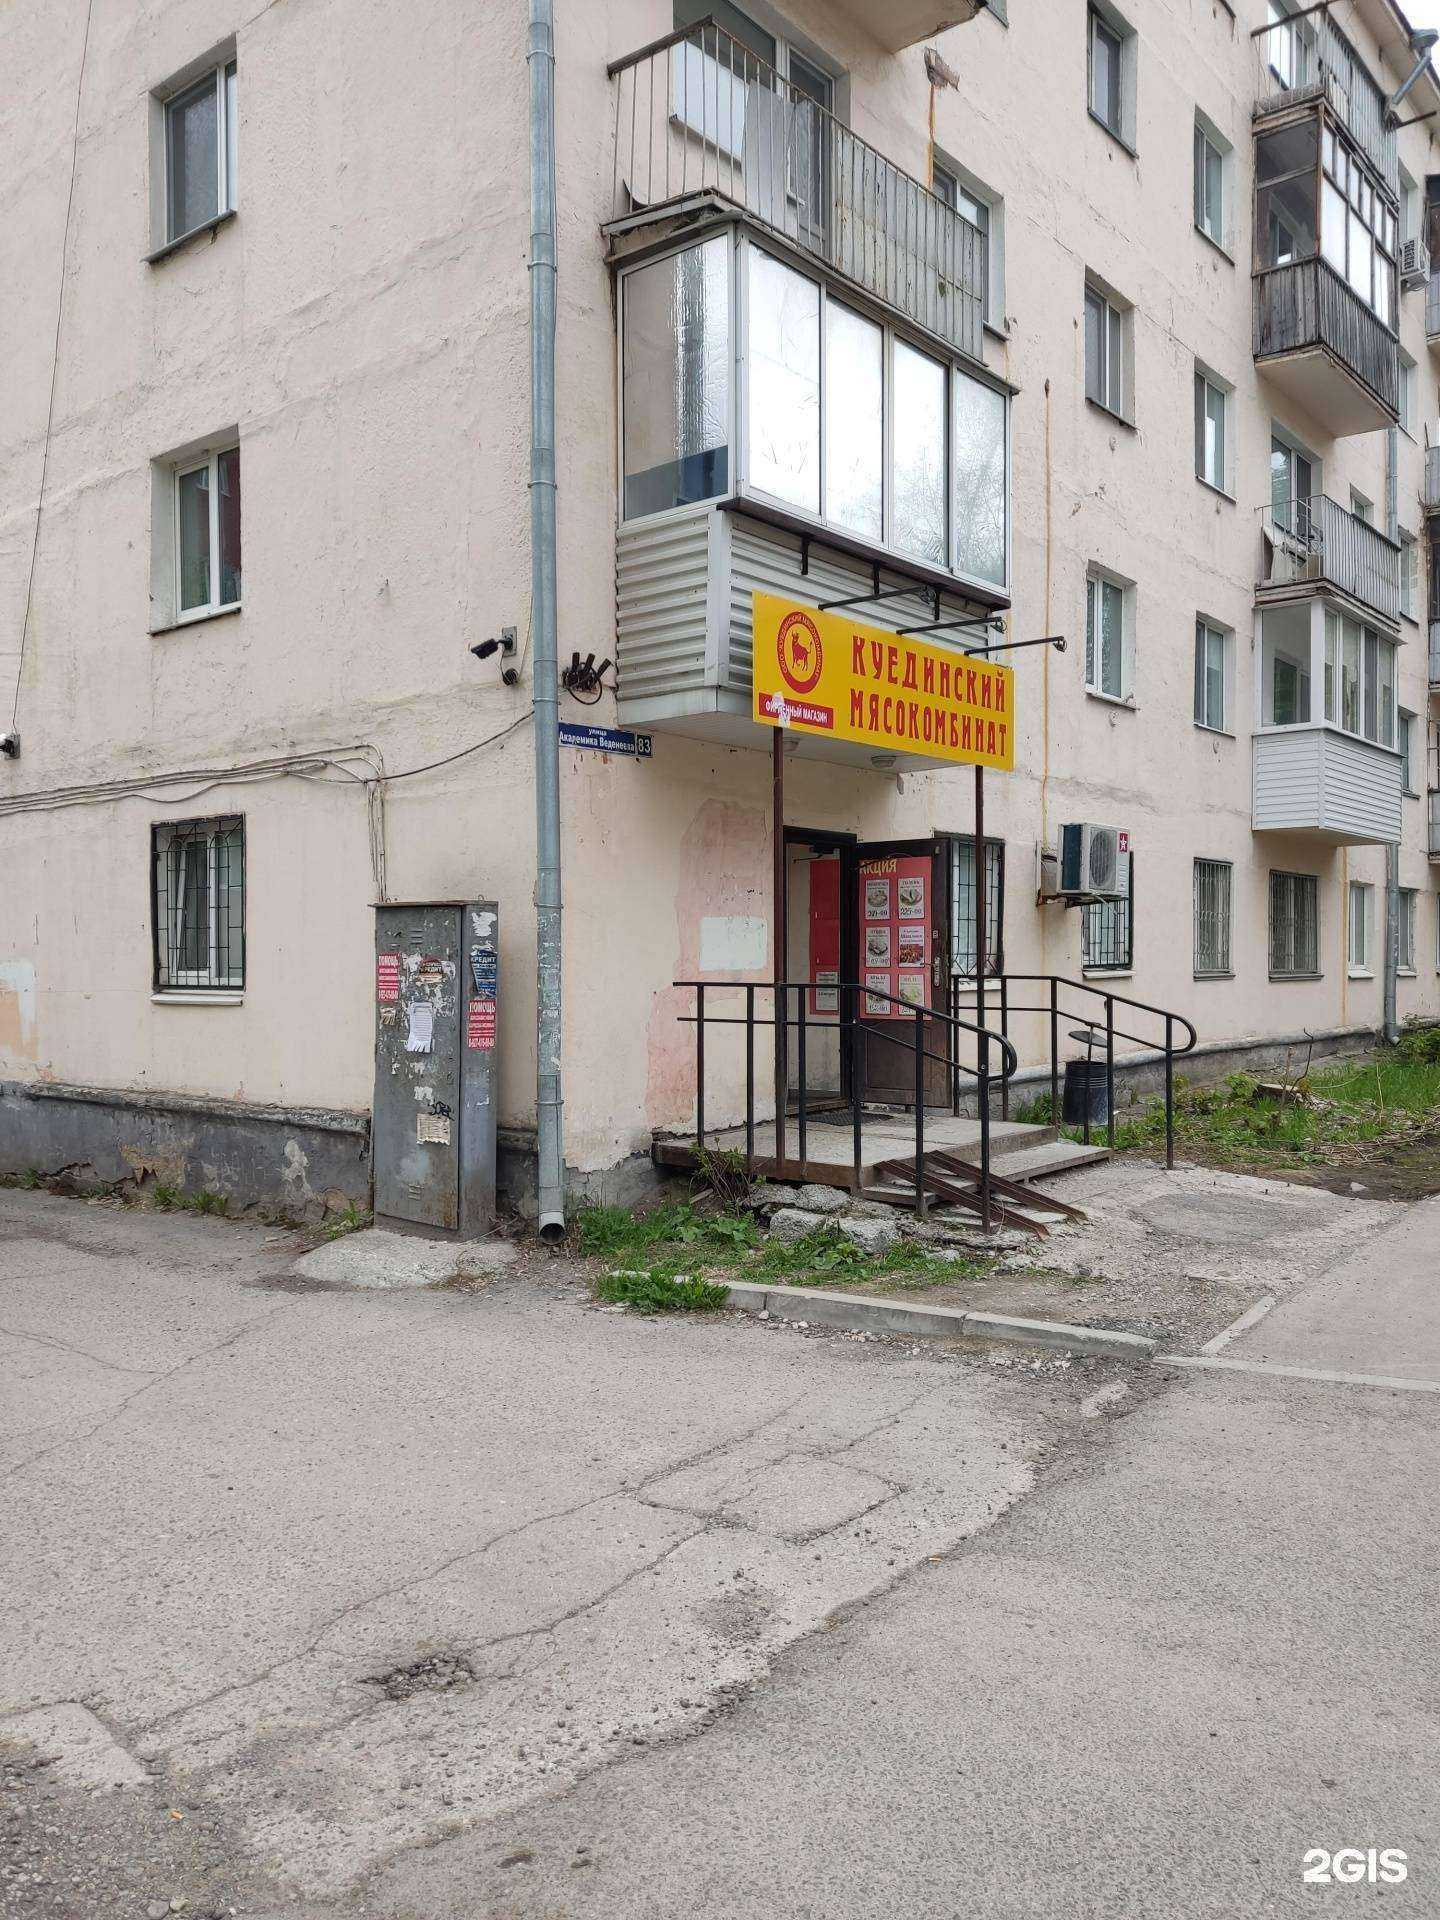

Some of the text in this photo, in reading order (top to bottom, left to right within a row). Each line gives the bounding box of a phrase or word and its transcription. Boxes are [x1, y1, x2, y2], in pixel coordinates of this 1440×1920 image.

[852, 635, 1005, 712] КУЕДИНСКИЙ
[802, 708, 828, 723] МАГАЗИН
[850, 688, 1006, 757] МЯСОКОМБИНАТ
[560, 731, 634, 751] Академика Веденеева
[638, 739, 651, 753] 83
[470, 1002, 495, 1014] ПОМОЩЬ
